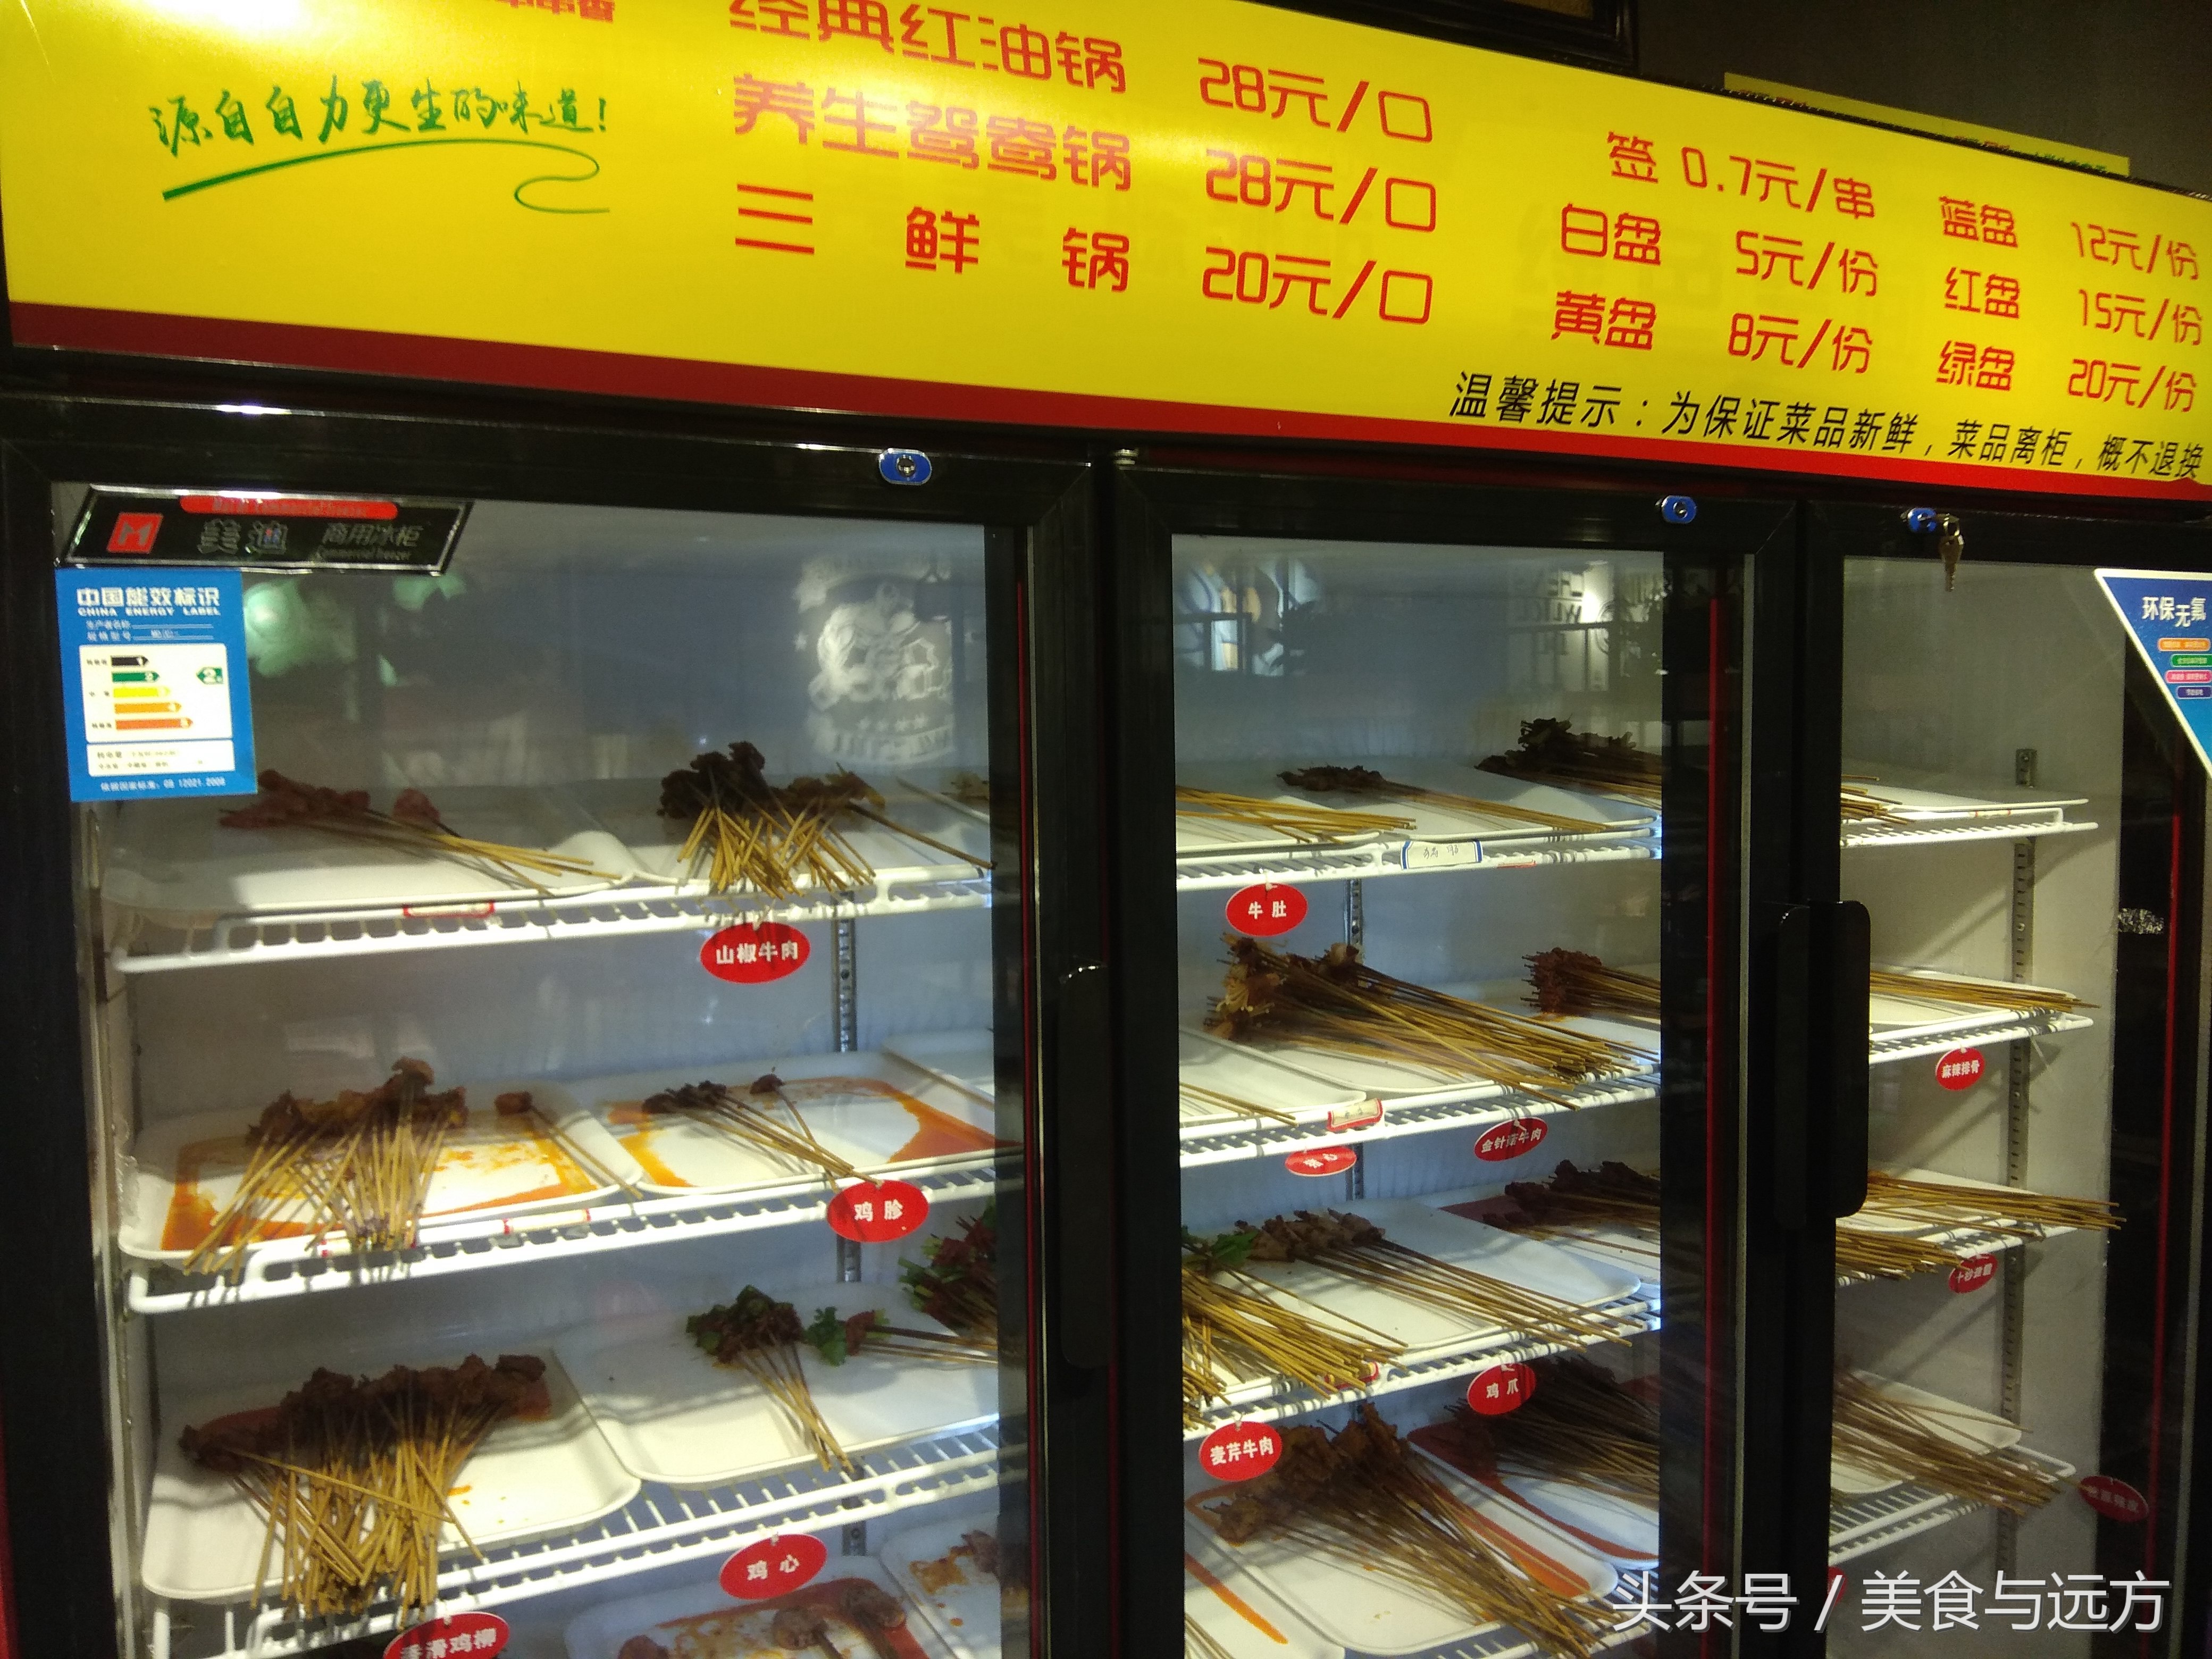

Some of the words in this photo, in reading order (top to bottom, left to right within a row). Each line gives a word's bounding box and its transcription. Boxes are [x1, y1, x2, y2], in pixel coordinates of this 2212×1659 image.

[1197, 57, 1432, 144] 28元/口
[734, 73, 1131, 191] 养生鸳鸯锅
[1205, 148, 1437, 233] 28元/口
[1681, 146, 1875, 219] 0.7元/串
[1938, 195, 2019, 248] 蓝盘
[2071, 222, 2199, 280] 12元/份
[1202, 246, 1433, 325] 20元/口
[1561, 203, 1662, 266] 白盘
[1735, 230, 1879, 297] 5元/份
[1944, 266, 2021, 319] 红盘
[2079, 289, 2202, 346] 15元/份
[1551, 289, 1656, 351] 黄盘
[1728, 312, 1873, 374] 8元/份
[1936, 340, 2016, 392] 绿盘
[2067, 358, 2197, 413] 20元/份
[77, 586, 220, 607] 中国能效标识
[78, 607, 118, 617] CHINA
[125, 606, 175, 616] ENERGY
[182, 606, 221, 616] LABEL
[1248, 900, 1287, 919] 牛肚
[716, 940, 799, 965] 山椒牛肉
[1486, 1378, 1519, 1398] 鸡爪
[747, 1554, 800, 1581] 鸡心
